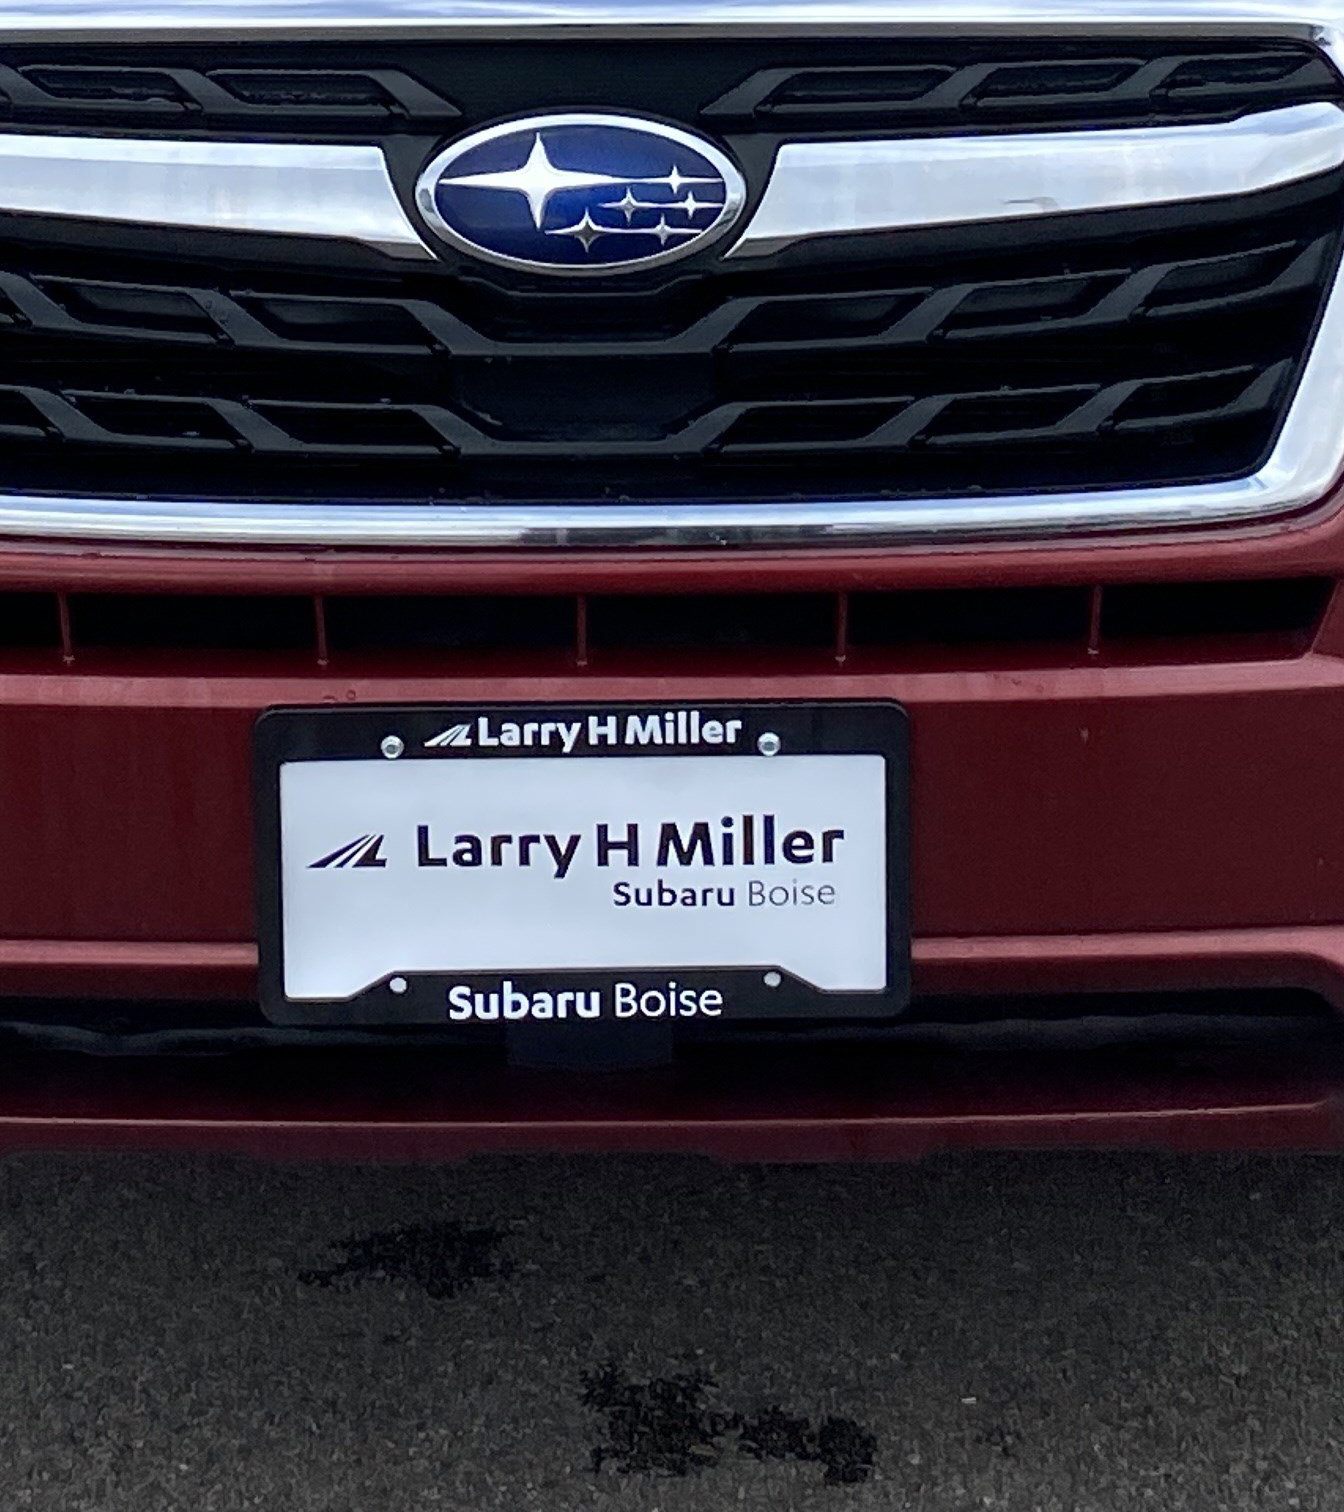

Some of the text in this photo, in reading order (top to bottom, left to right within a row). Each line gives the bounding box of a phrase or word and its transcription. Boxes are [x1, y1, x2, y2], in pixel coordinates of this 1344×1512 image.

[477, 710, 742, 754] Larry H Miller
[416, 814, 845, 880] Larry H Miller
[613, 878, 837, 908] Subaru Boise
[448, 980, 724, 1021] Subaru Boise
